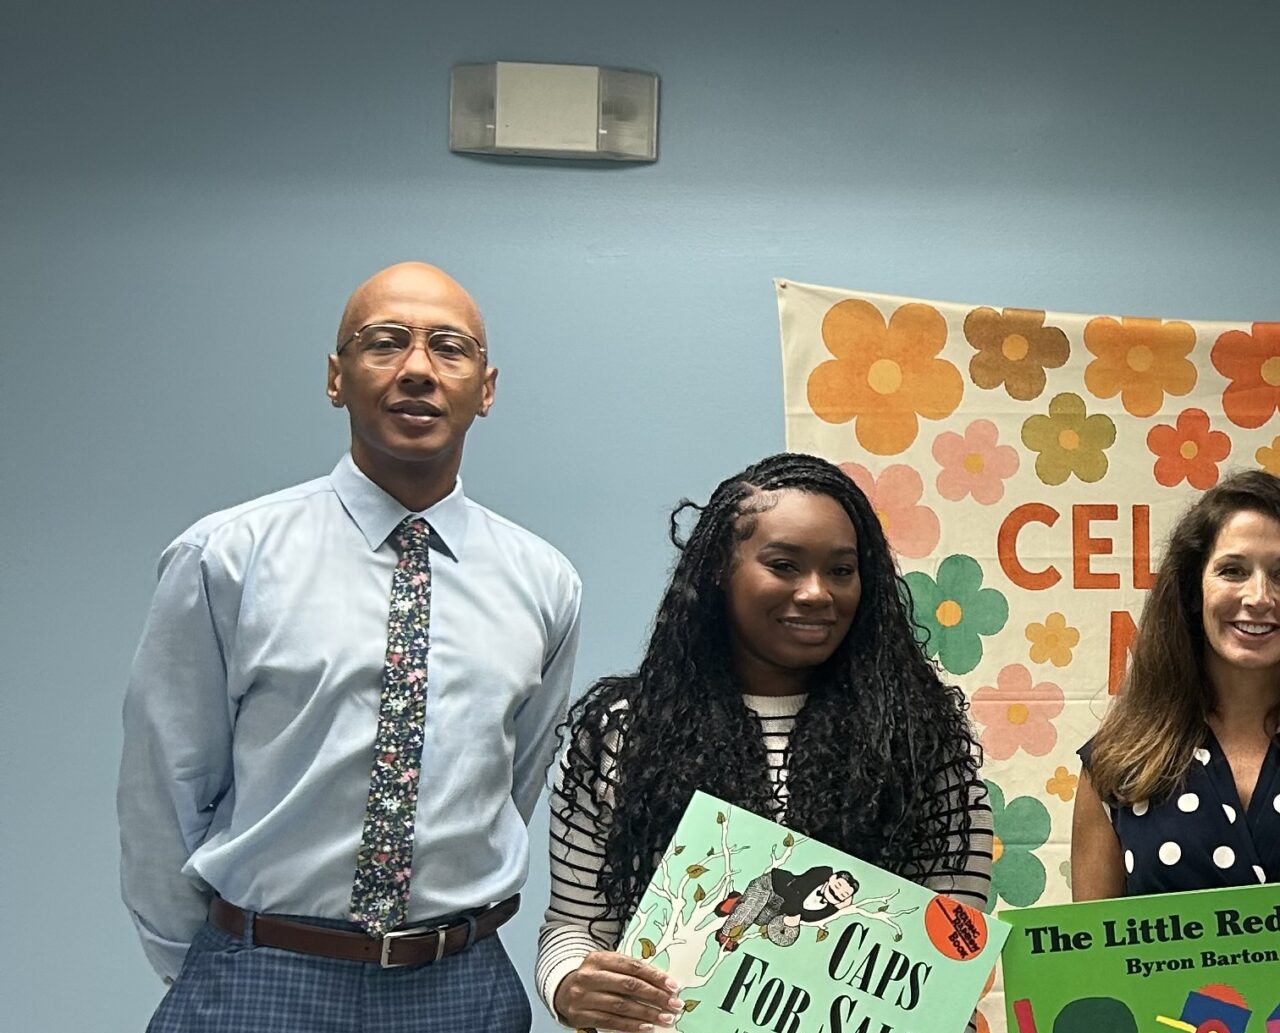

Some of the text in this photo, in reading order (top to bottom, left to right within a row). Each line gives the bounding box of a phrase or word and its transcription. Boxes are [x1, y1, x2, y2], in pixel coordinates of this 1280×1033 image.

[1025, 926, 1093, 955] The
[1102, 914, 1204, 948] Little
[828, 921, 932, 1011] CAPS
[1125, 949, 1280, 978] Byron Barton
